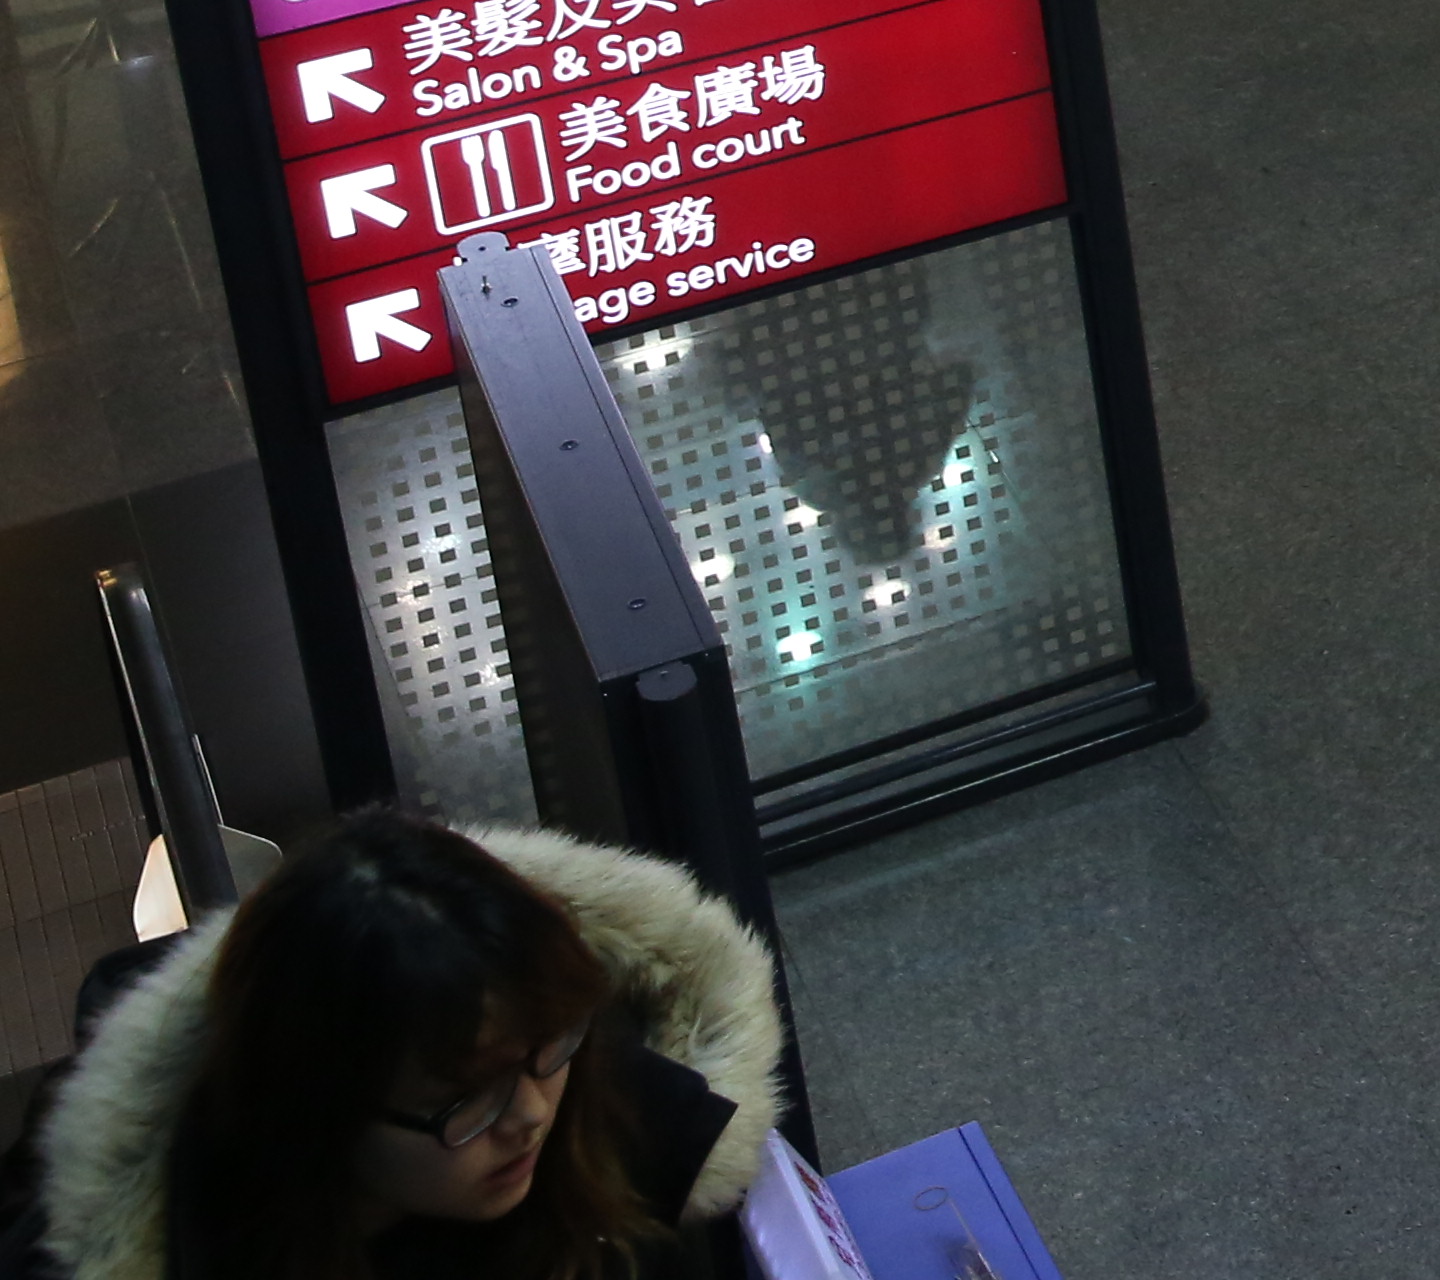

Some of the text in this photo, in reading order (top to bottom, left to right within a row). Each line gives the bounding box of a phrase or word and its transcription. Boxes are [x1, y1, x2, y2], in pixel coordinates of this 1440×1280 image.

[413, 28, 684, 118] Salon & Spa
[558, 44, 826, 162] 美食廣場
[565, 116, 806, 202] Food court
[668, 236, 814, 299] service
